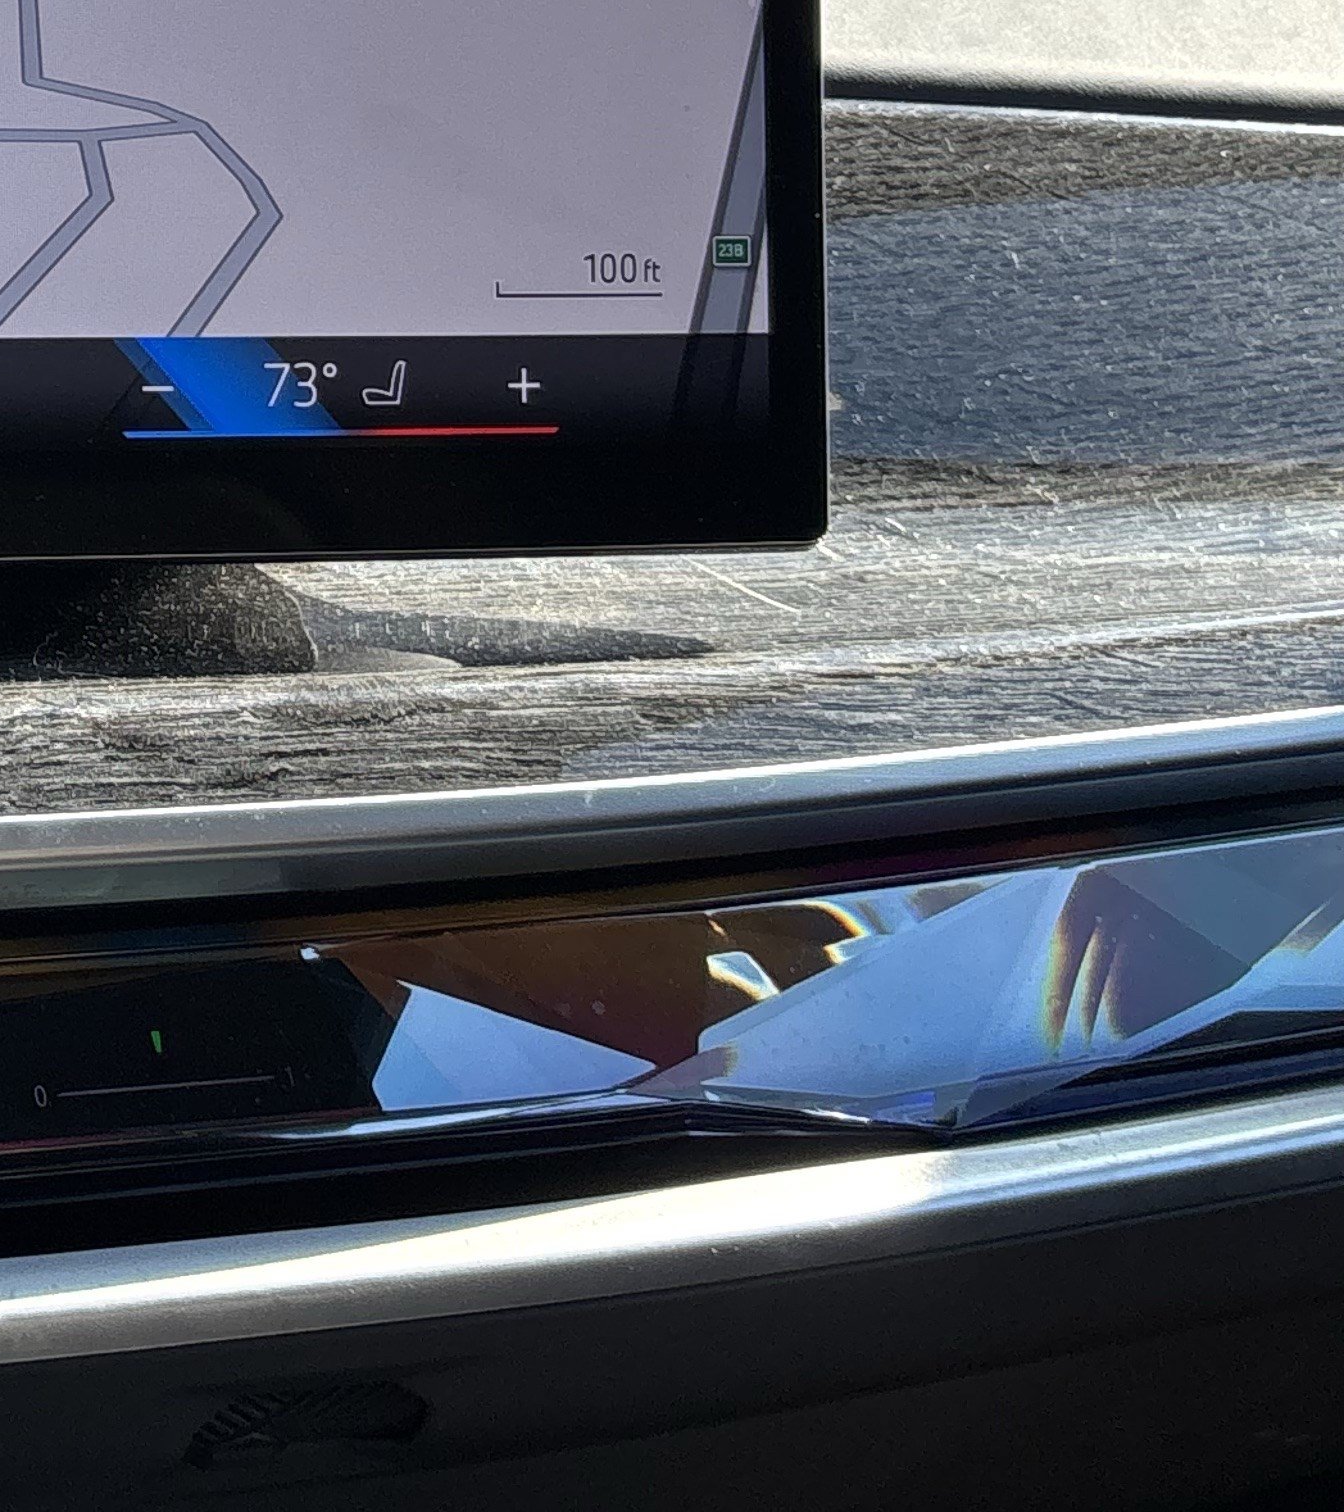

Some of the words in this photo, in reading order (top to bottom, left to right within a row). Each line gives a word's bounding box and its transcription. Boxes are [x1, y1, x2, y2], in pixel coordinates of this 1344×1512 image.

[583, 253, 637, 284] 100
[643, 258, 662, 283] ft
[263, 362, 338, 408] 73°
[34, 1085, 47, 1108] 0
